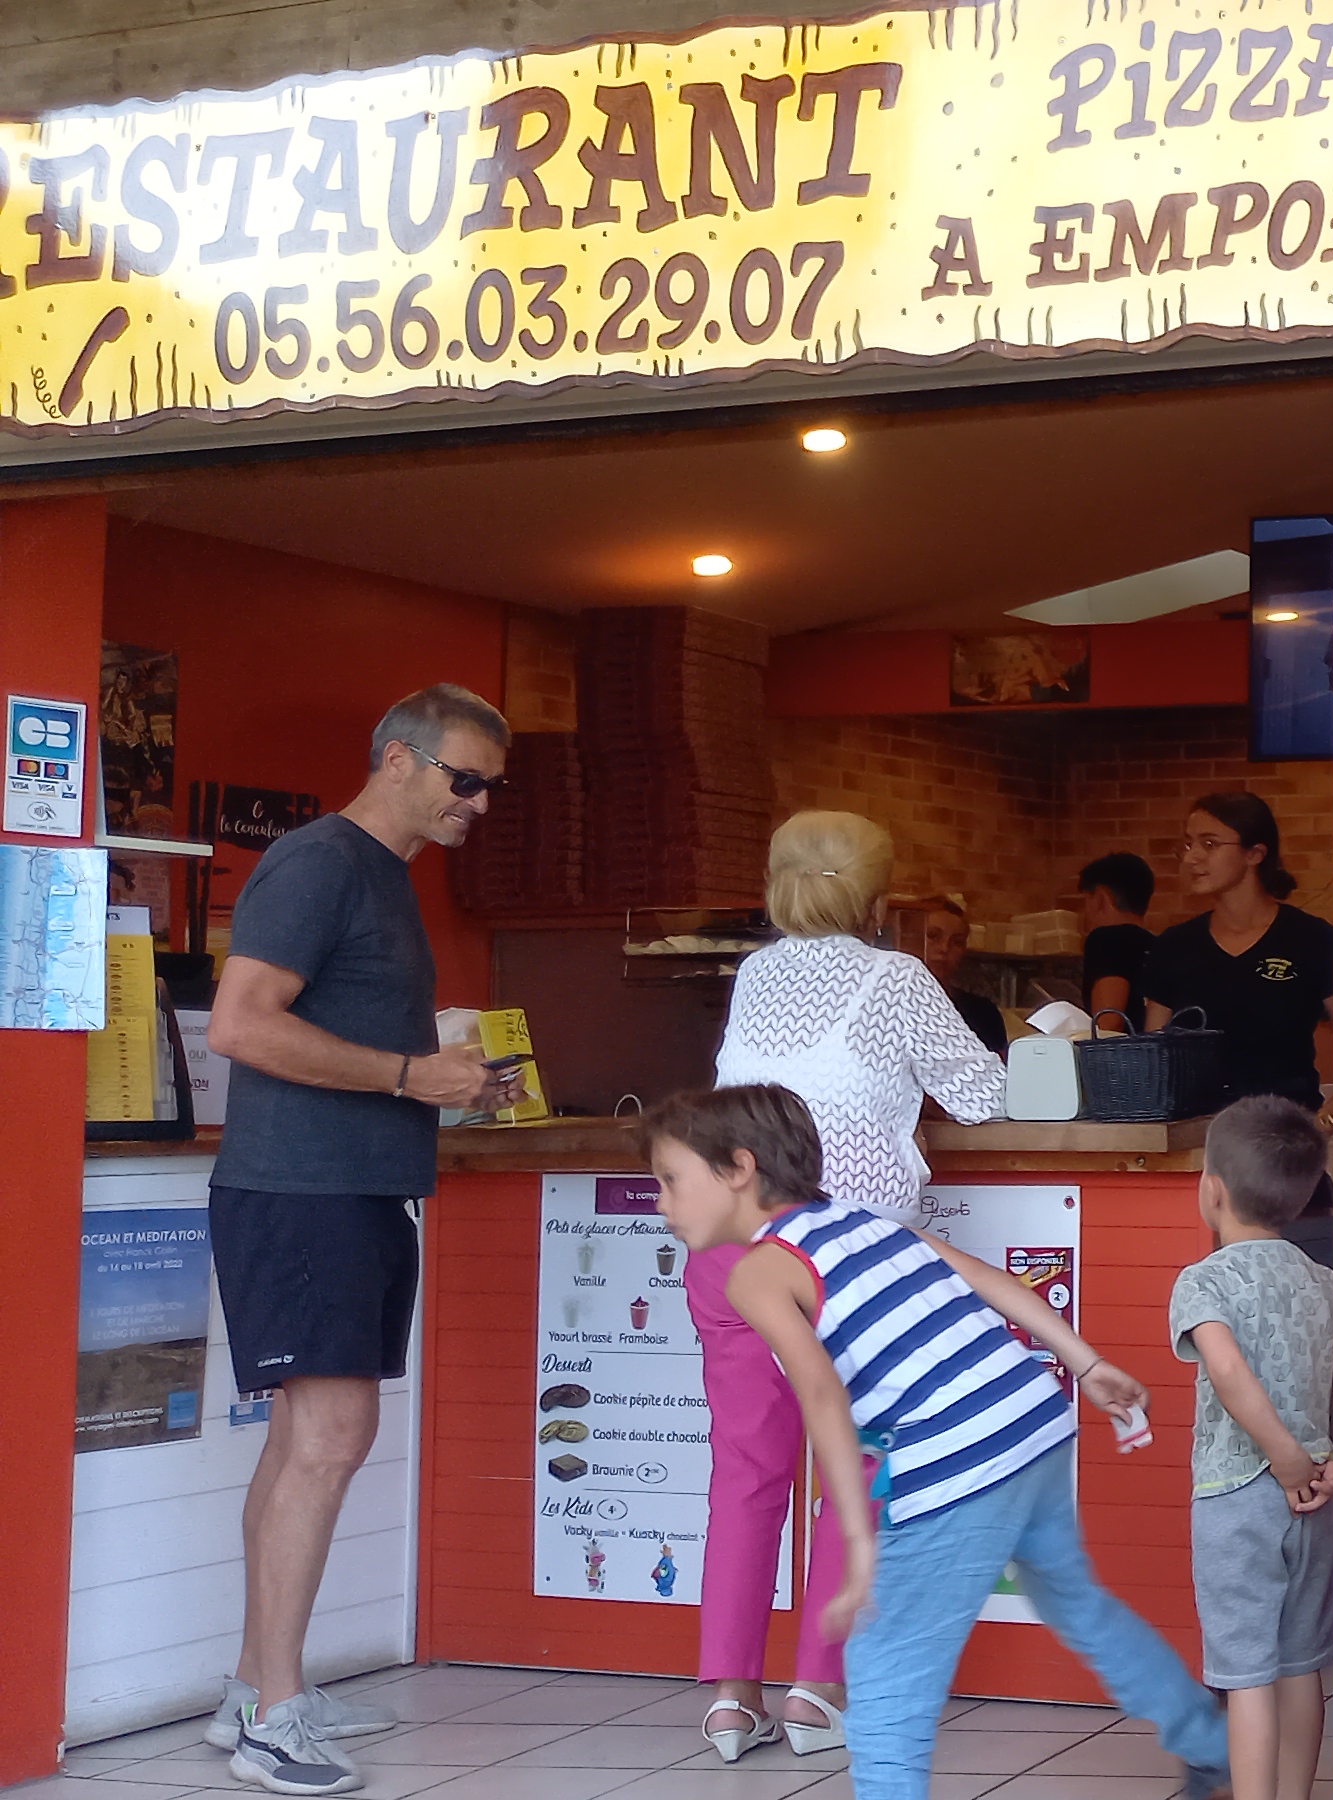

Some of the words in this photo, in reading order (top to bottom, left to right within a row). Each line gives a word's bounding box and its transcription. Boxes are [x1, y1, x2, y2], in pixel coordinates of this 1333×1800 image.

[0, 62, 903, 299] ESTAURANT
[921, 214, 993, 301] A
[213, 240, 845, 385] 05.56.03.29.07
[18, 716, 71, 749] CB
[81, 1233, 120, 1246] OCEAN
[124, 1231, 133, 1243] ET
[136, 1229, 206, 1242] MEDITATION
[574, 1276, 607, 1287] Vanille
[649, 1278, 686, 1288] Chocol
[593, 1393, 627, 1405] Cookie
[663, 1394, 676, 1407] de
[678, 1395, 709, 1408] choco
[592, 1429, 627, 1441] Cookie
[628, 1429, 665, 1442] double
[592, 1464, 635, 1476] Brownie
[562, 1496, 593, 1518] Kids
